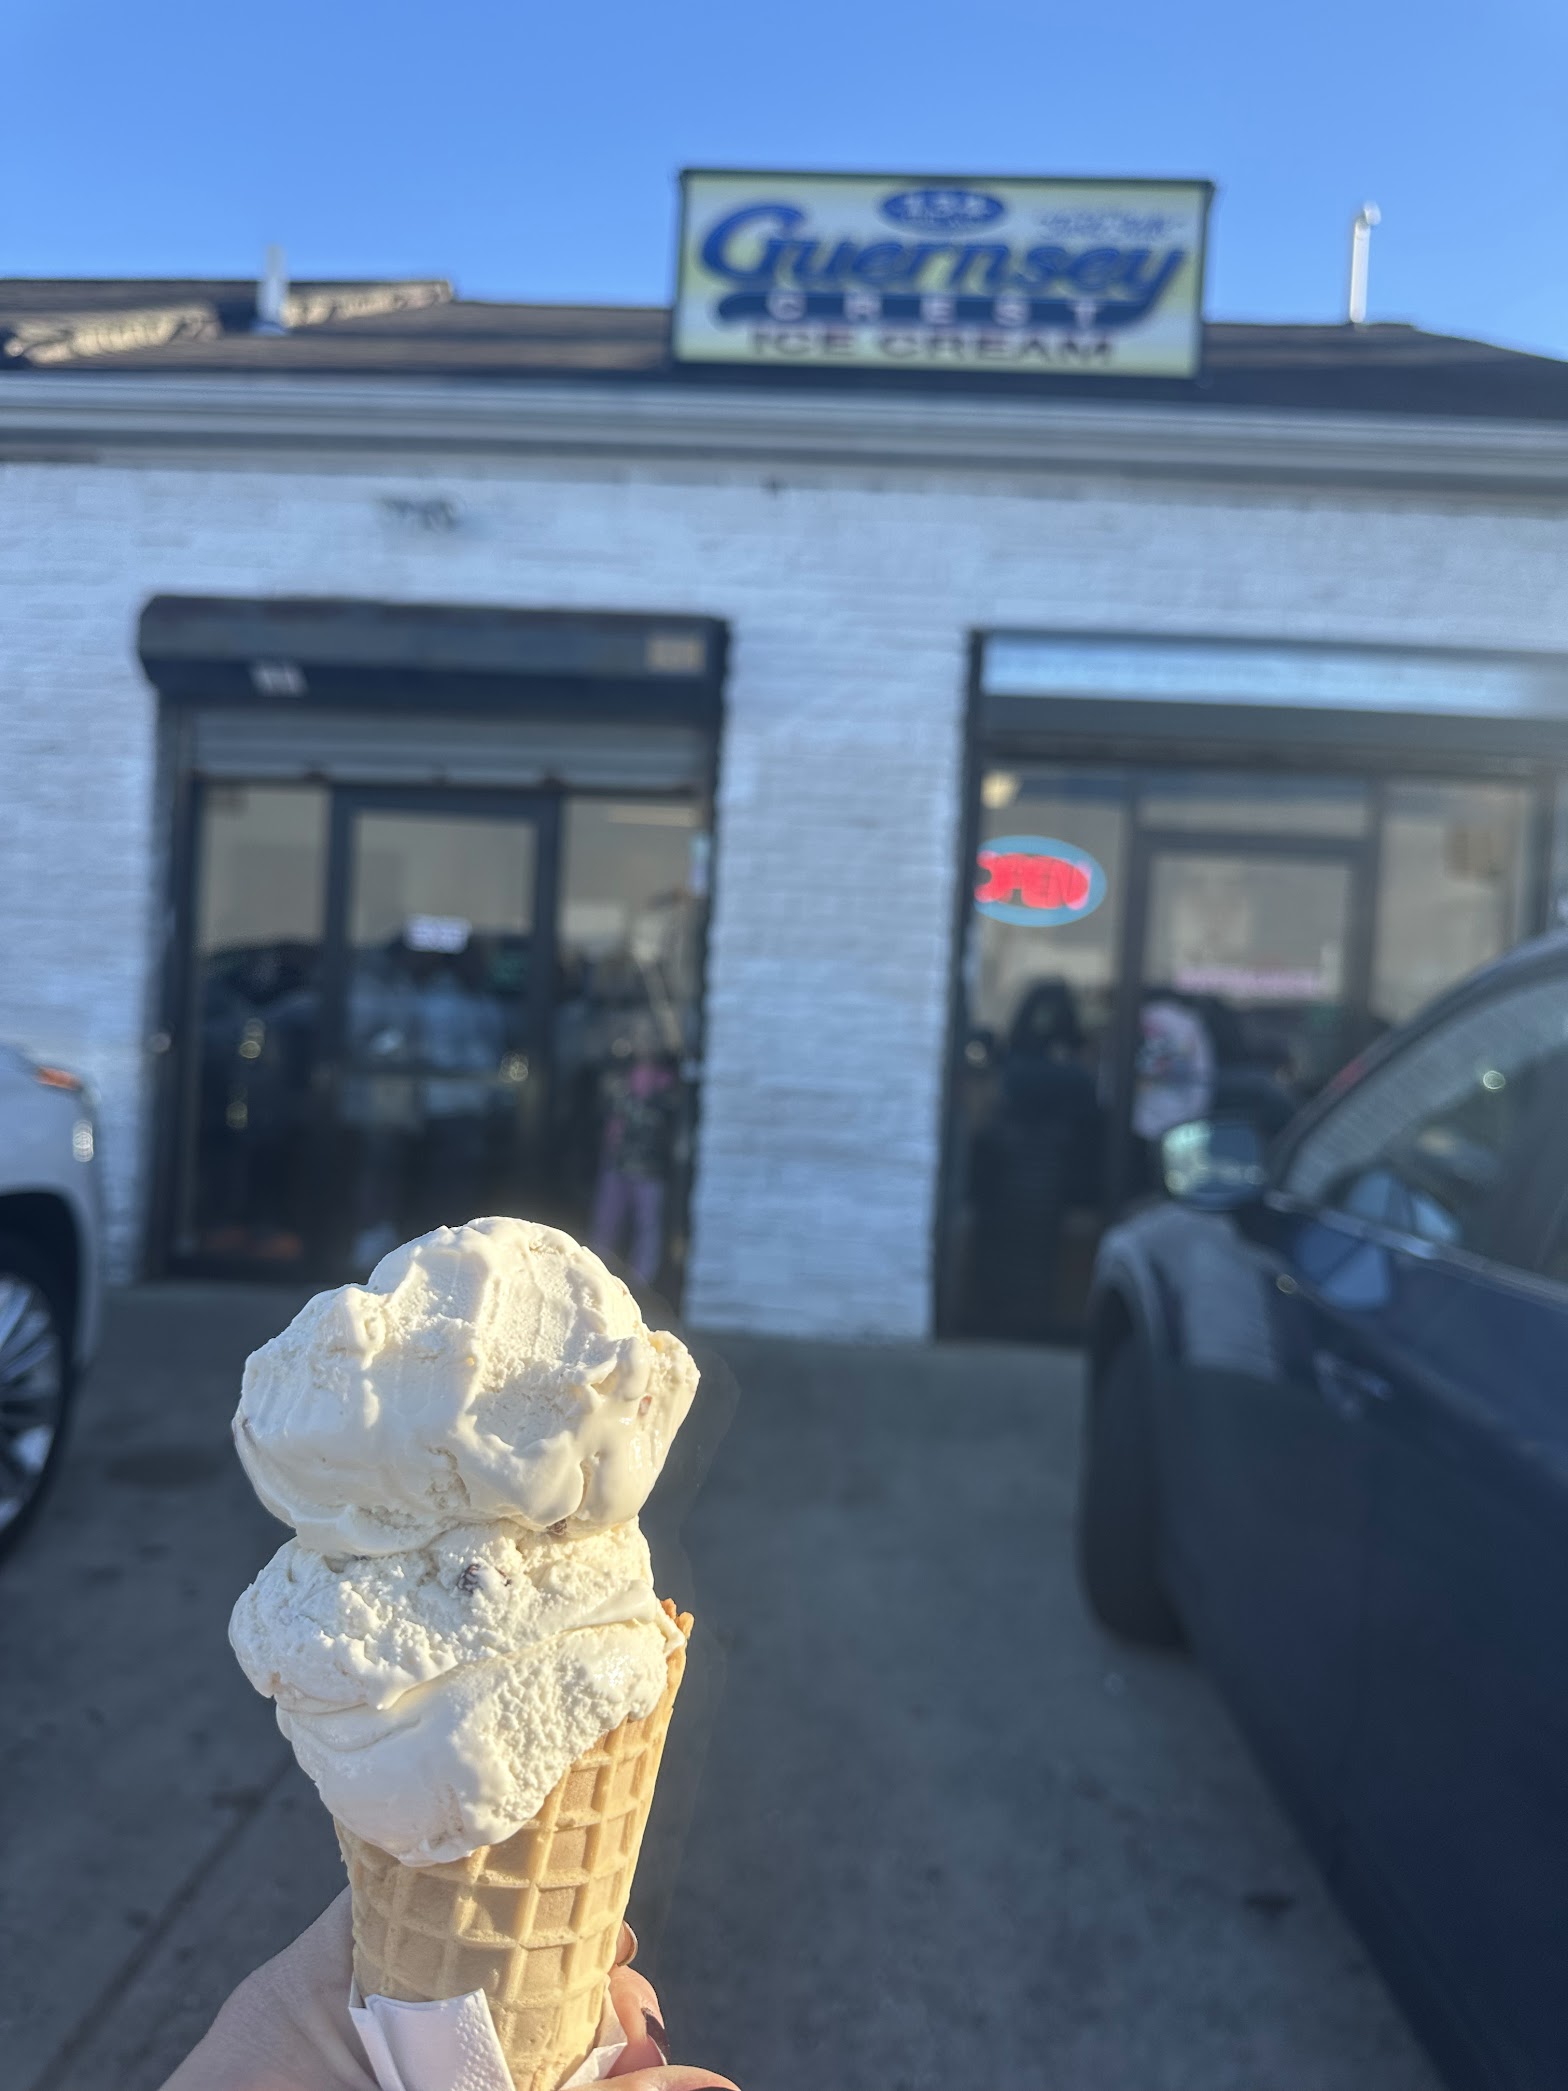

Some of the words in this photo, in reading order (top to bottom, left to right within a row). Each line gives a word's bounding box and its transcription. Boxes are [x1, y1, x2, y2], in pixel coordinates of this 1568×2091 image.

[702, 205, 1186, 304] Guernsey
[766, 289, 1103, 330] CREST
[751, 326, 856, 358] ICE
[881, 329, 1115, 366] CREAM
